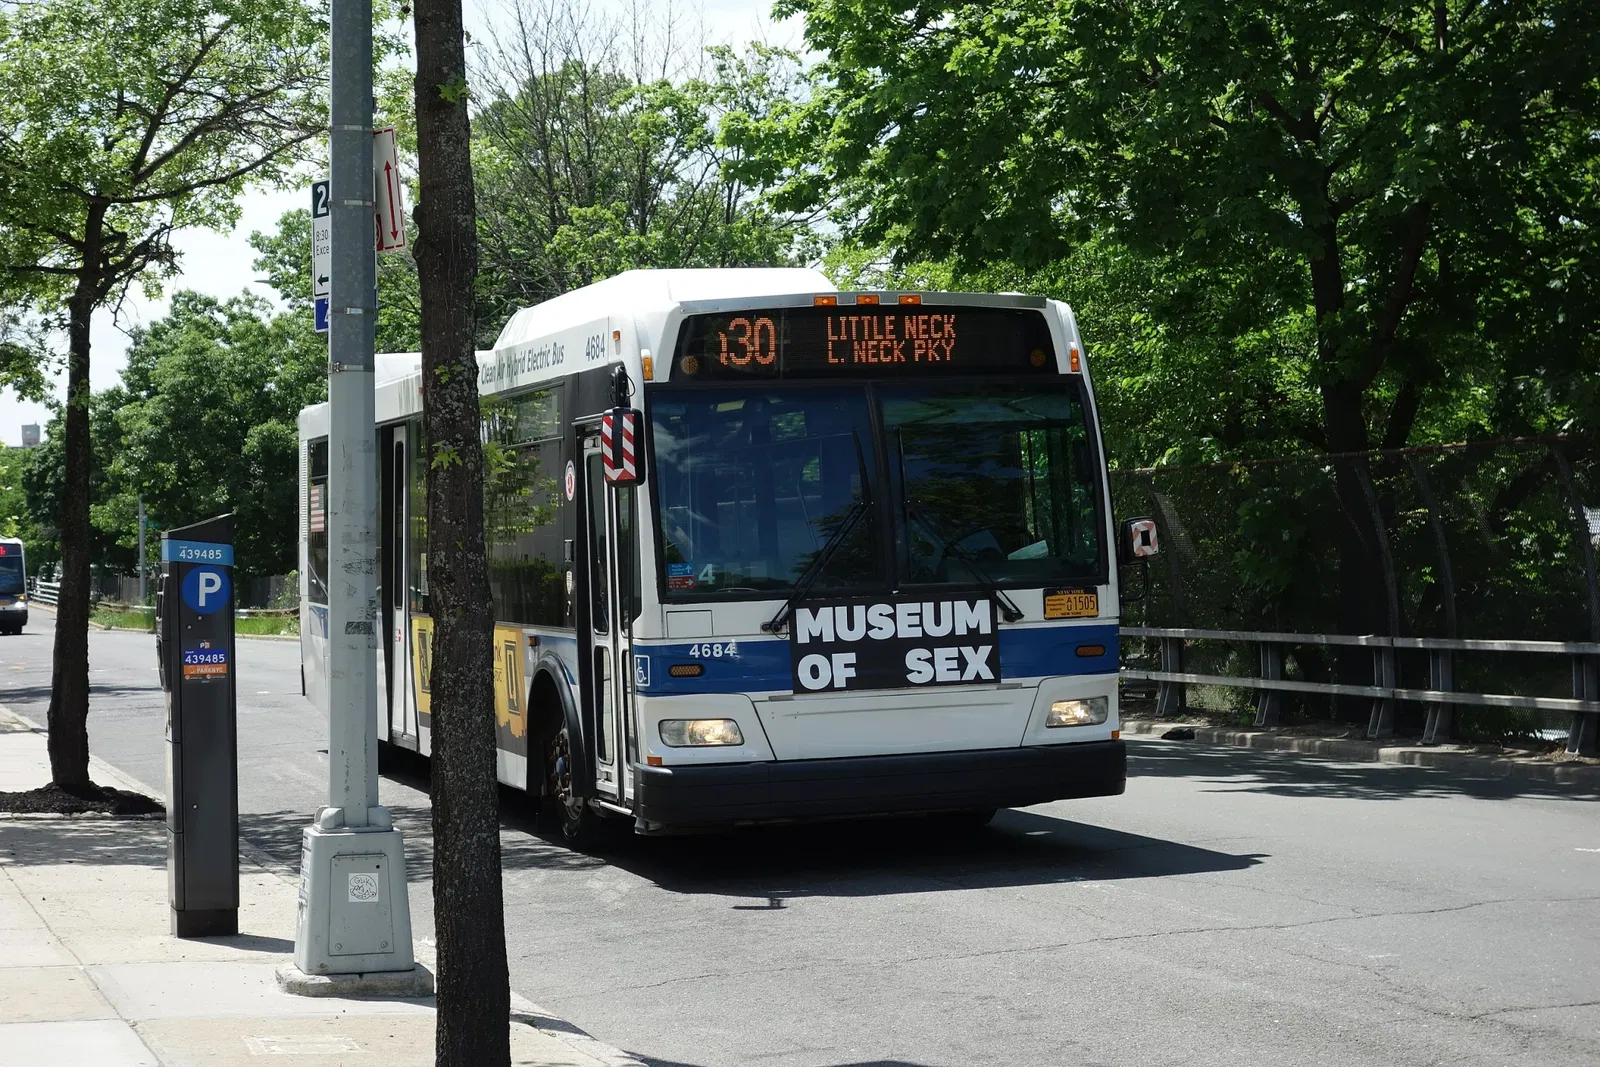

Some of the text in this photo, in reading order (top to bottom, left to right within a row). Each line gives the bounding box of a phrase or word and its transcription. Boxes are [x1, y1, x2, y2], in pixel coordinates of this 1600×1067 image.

[317, 184, 328, 215] 2
[827, 314, 956, 340] LITTLE NECK
[586, 333, 605, 361] 4684
[828, 339, 955, 363] L. NECK PKY
[481, 342, 565, 384] Clean Air Hybrid Electric Bus
[179, 549, 222, 559] 439485
[699, 563, 716, 585] 4
[199, 572, 222, 607] P
[795, 599, 992, 644] MUSEUM
[185, 654, 225, 664] 439485
[689, 643, 734, 658] 4684
[797, 645, 995, 690] OF SEX
